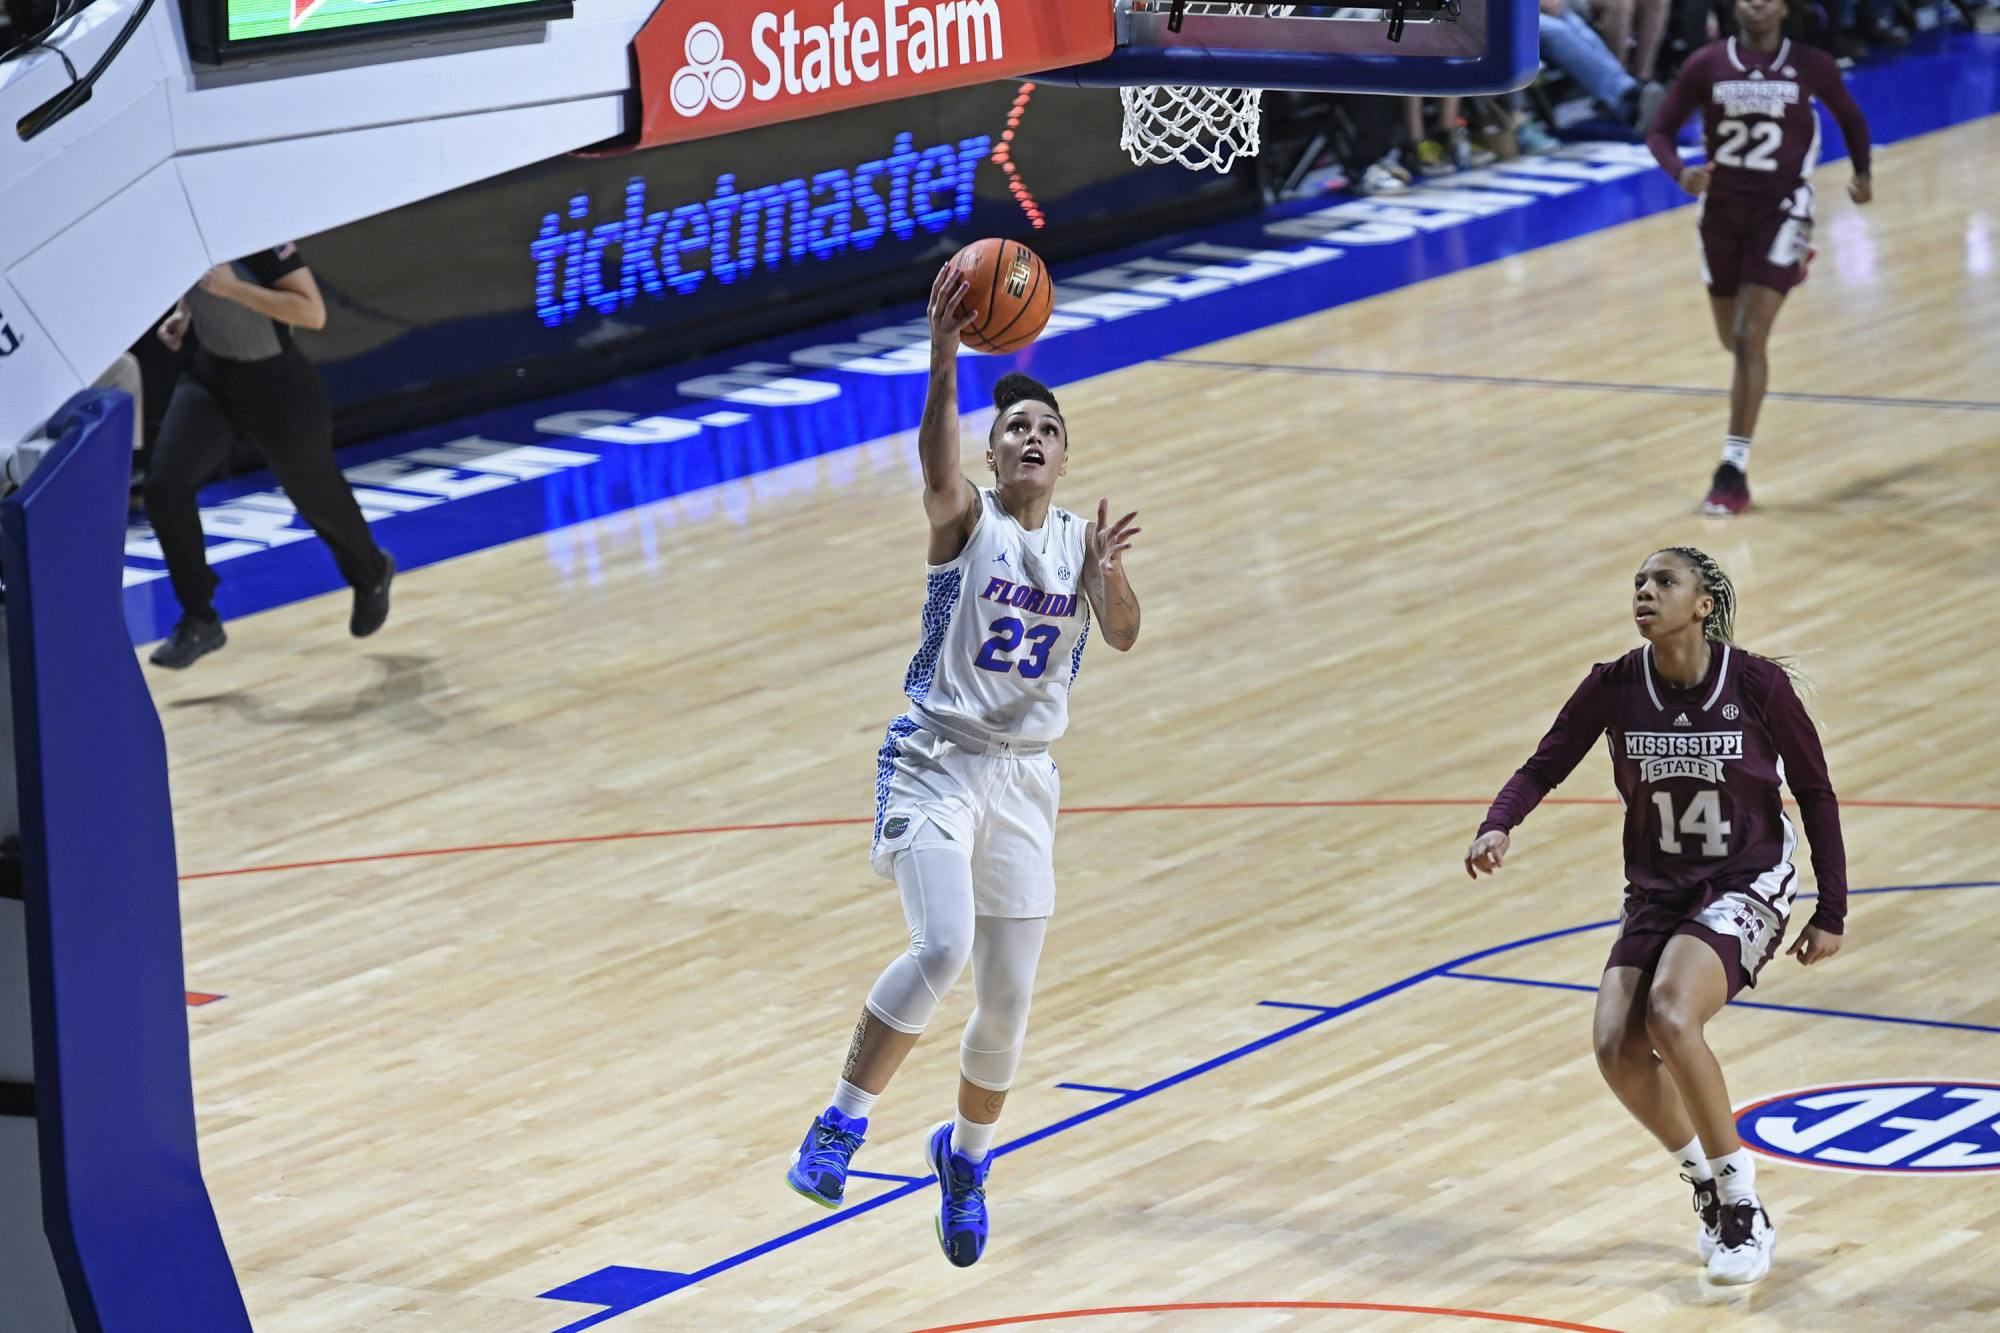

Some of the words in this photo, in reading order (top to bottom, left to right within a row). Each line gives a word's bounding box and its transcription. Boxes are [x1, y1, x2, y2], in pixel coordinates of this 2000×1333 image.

[1715, 119, 1784, 172] 22
[531, 131, 991, 328] ticketmaster
[980, 576, 1078, 618] FLORIDA
[974, 616, 1061, 679] 23
[1723, 704, 1739, 720] SEC
[1625, 735, 1743, 756] MISSISSIPPI
[1653, 759, 1709, 778] STATE
[1651, 789, 1732, 857] 14
